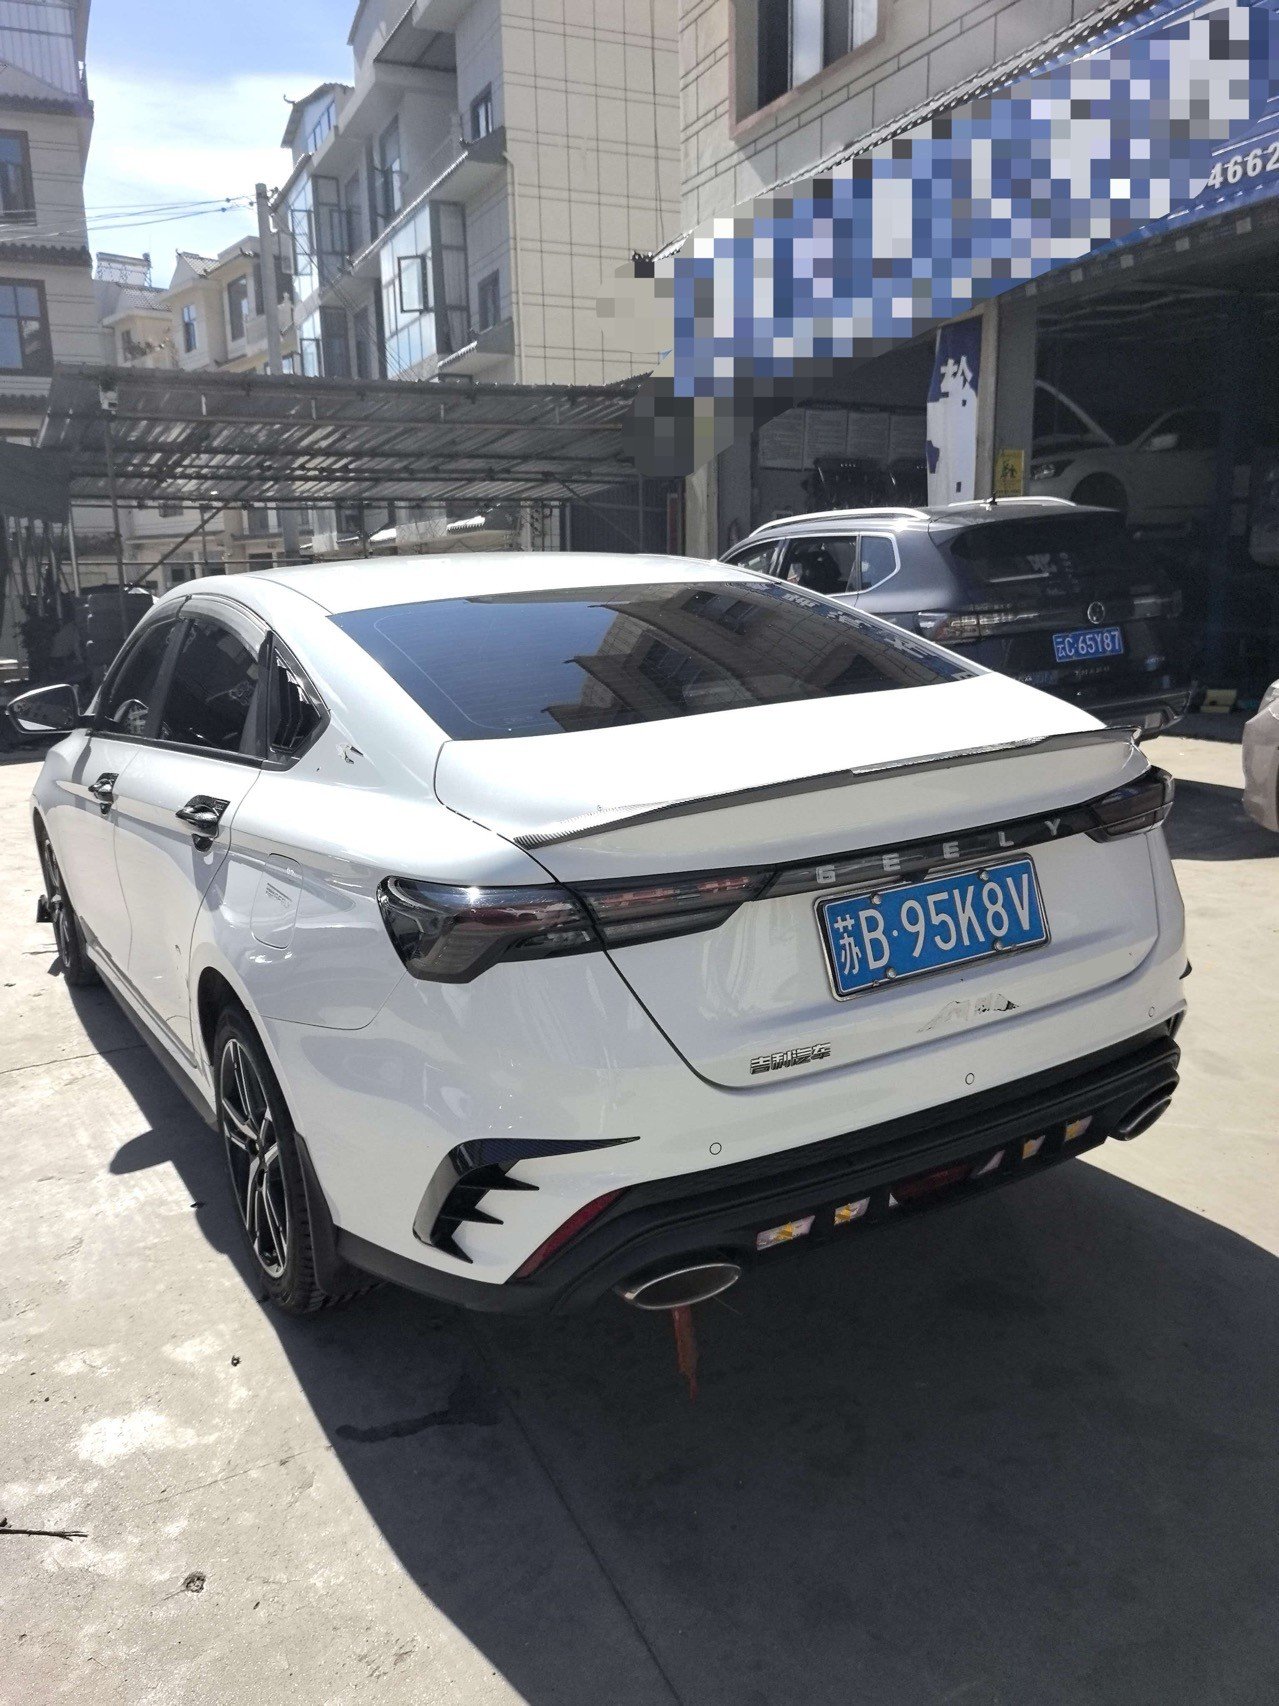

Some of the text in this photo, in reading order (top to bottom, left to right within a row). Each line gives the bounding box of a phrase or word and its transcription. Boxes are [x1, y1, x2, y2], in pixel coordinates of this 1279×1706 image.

[815, 818, 1061, 884] GEELY
[833, 873, 1031, 975] 苏B·95K8V
[750, 1041, 832, 1075] 吉利汽车
